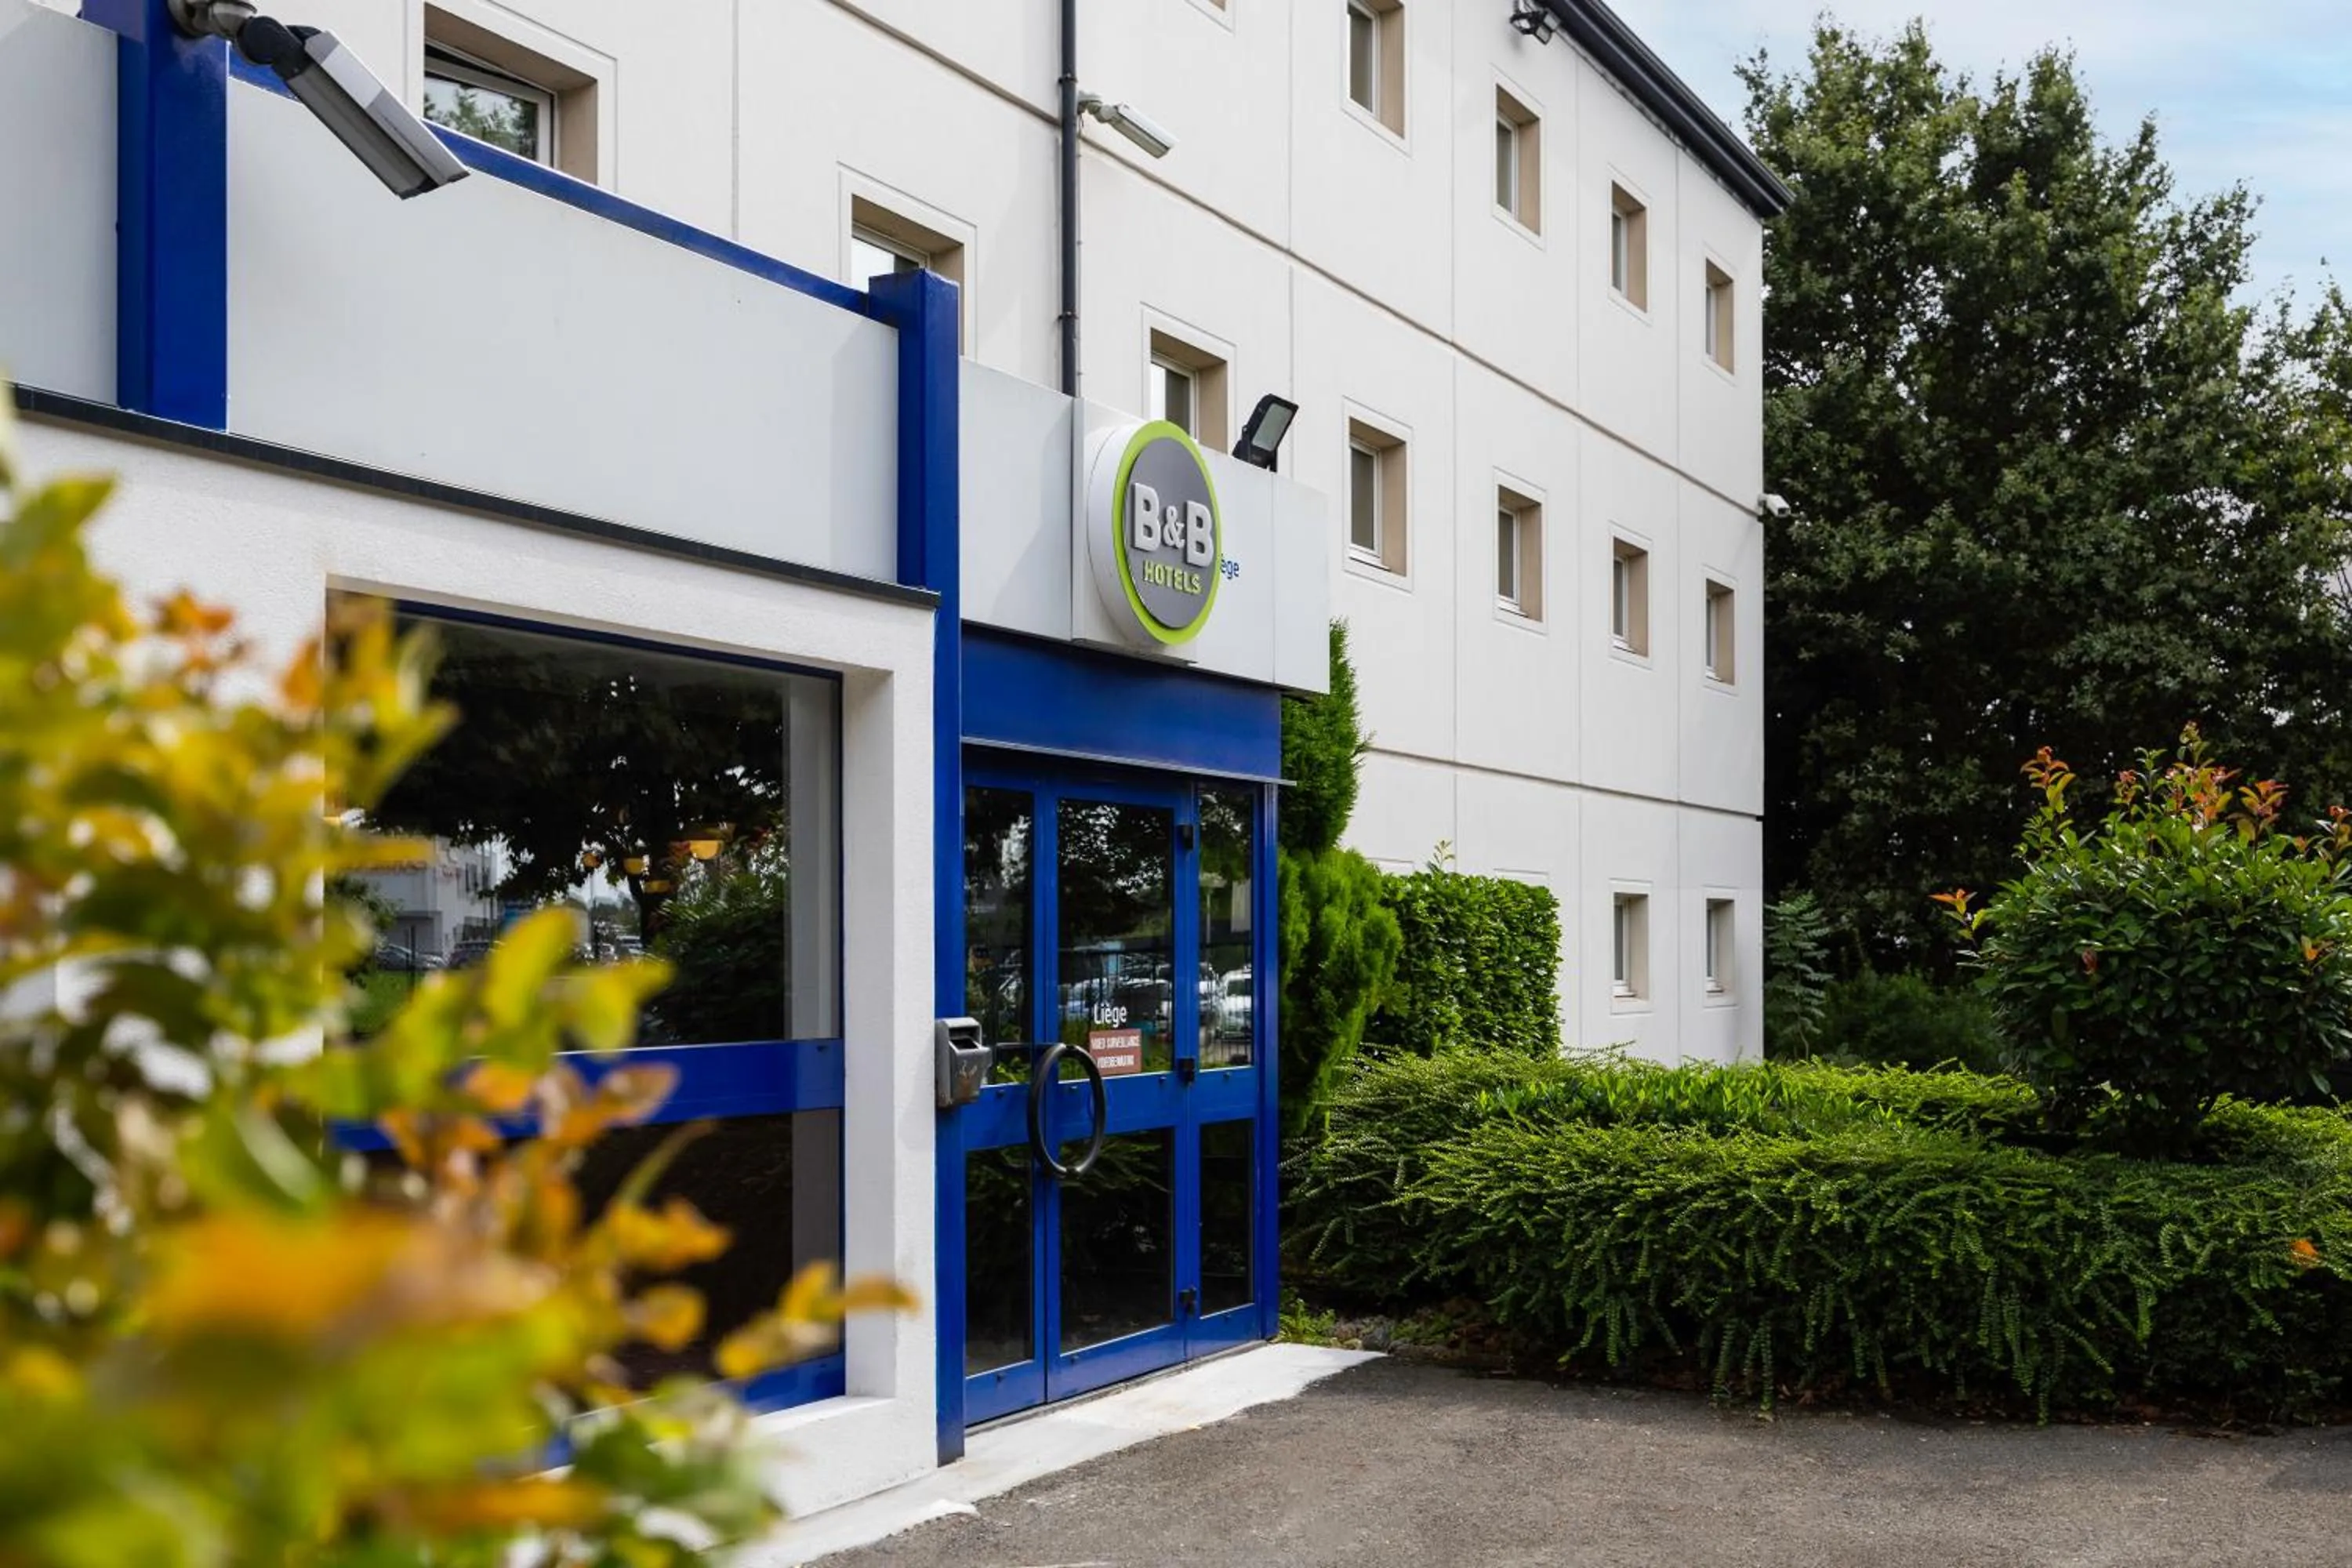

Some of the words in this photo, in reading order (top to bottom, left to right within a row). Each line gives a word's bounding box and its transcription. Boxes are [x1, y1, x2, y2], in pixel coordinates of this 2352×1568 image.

[1134, 482, 1214, 567] B&B
[1143, 559, 1203, 595] HOTELS
[1094, 1002, 1127, 1028] Liège
